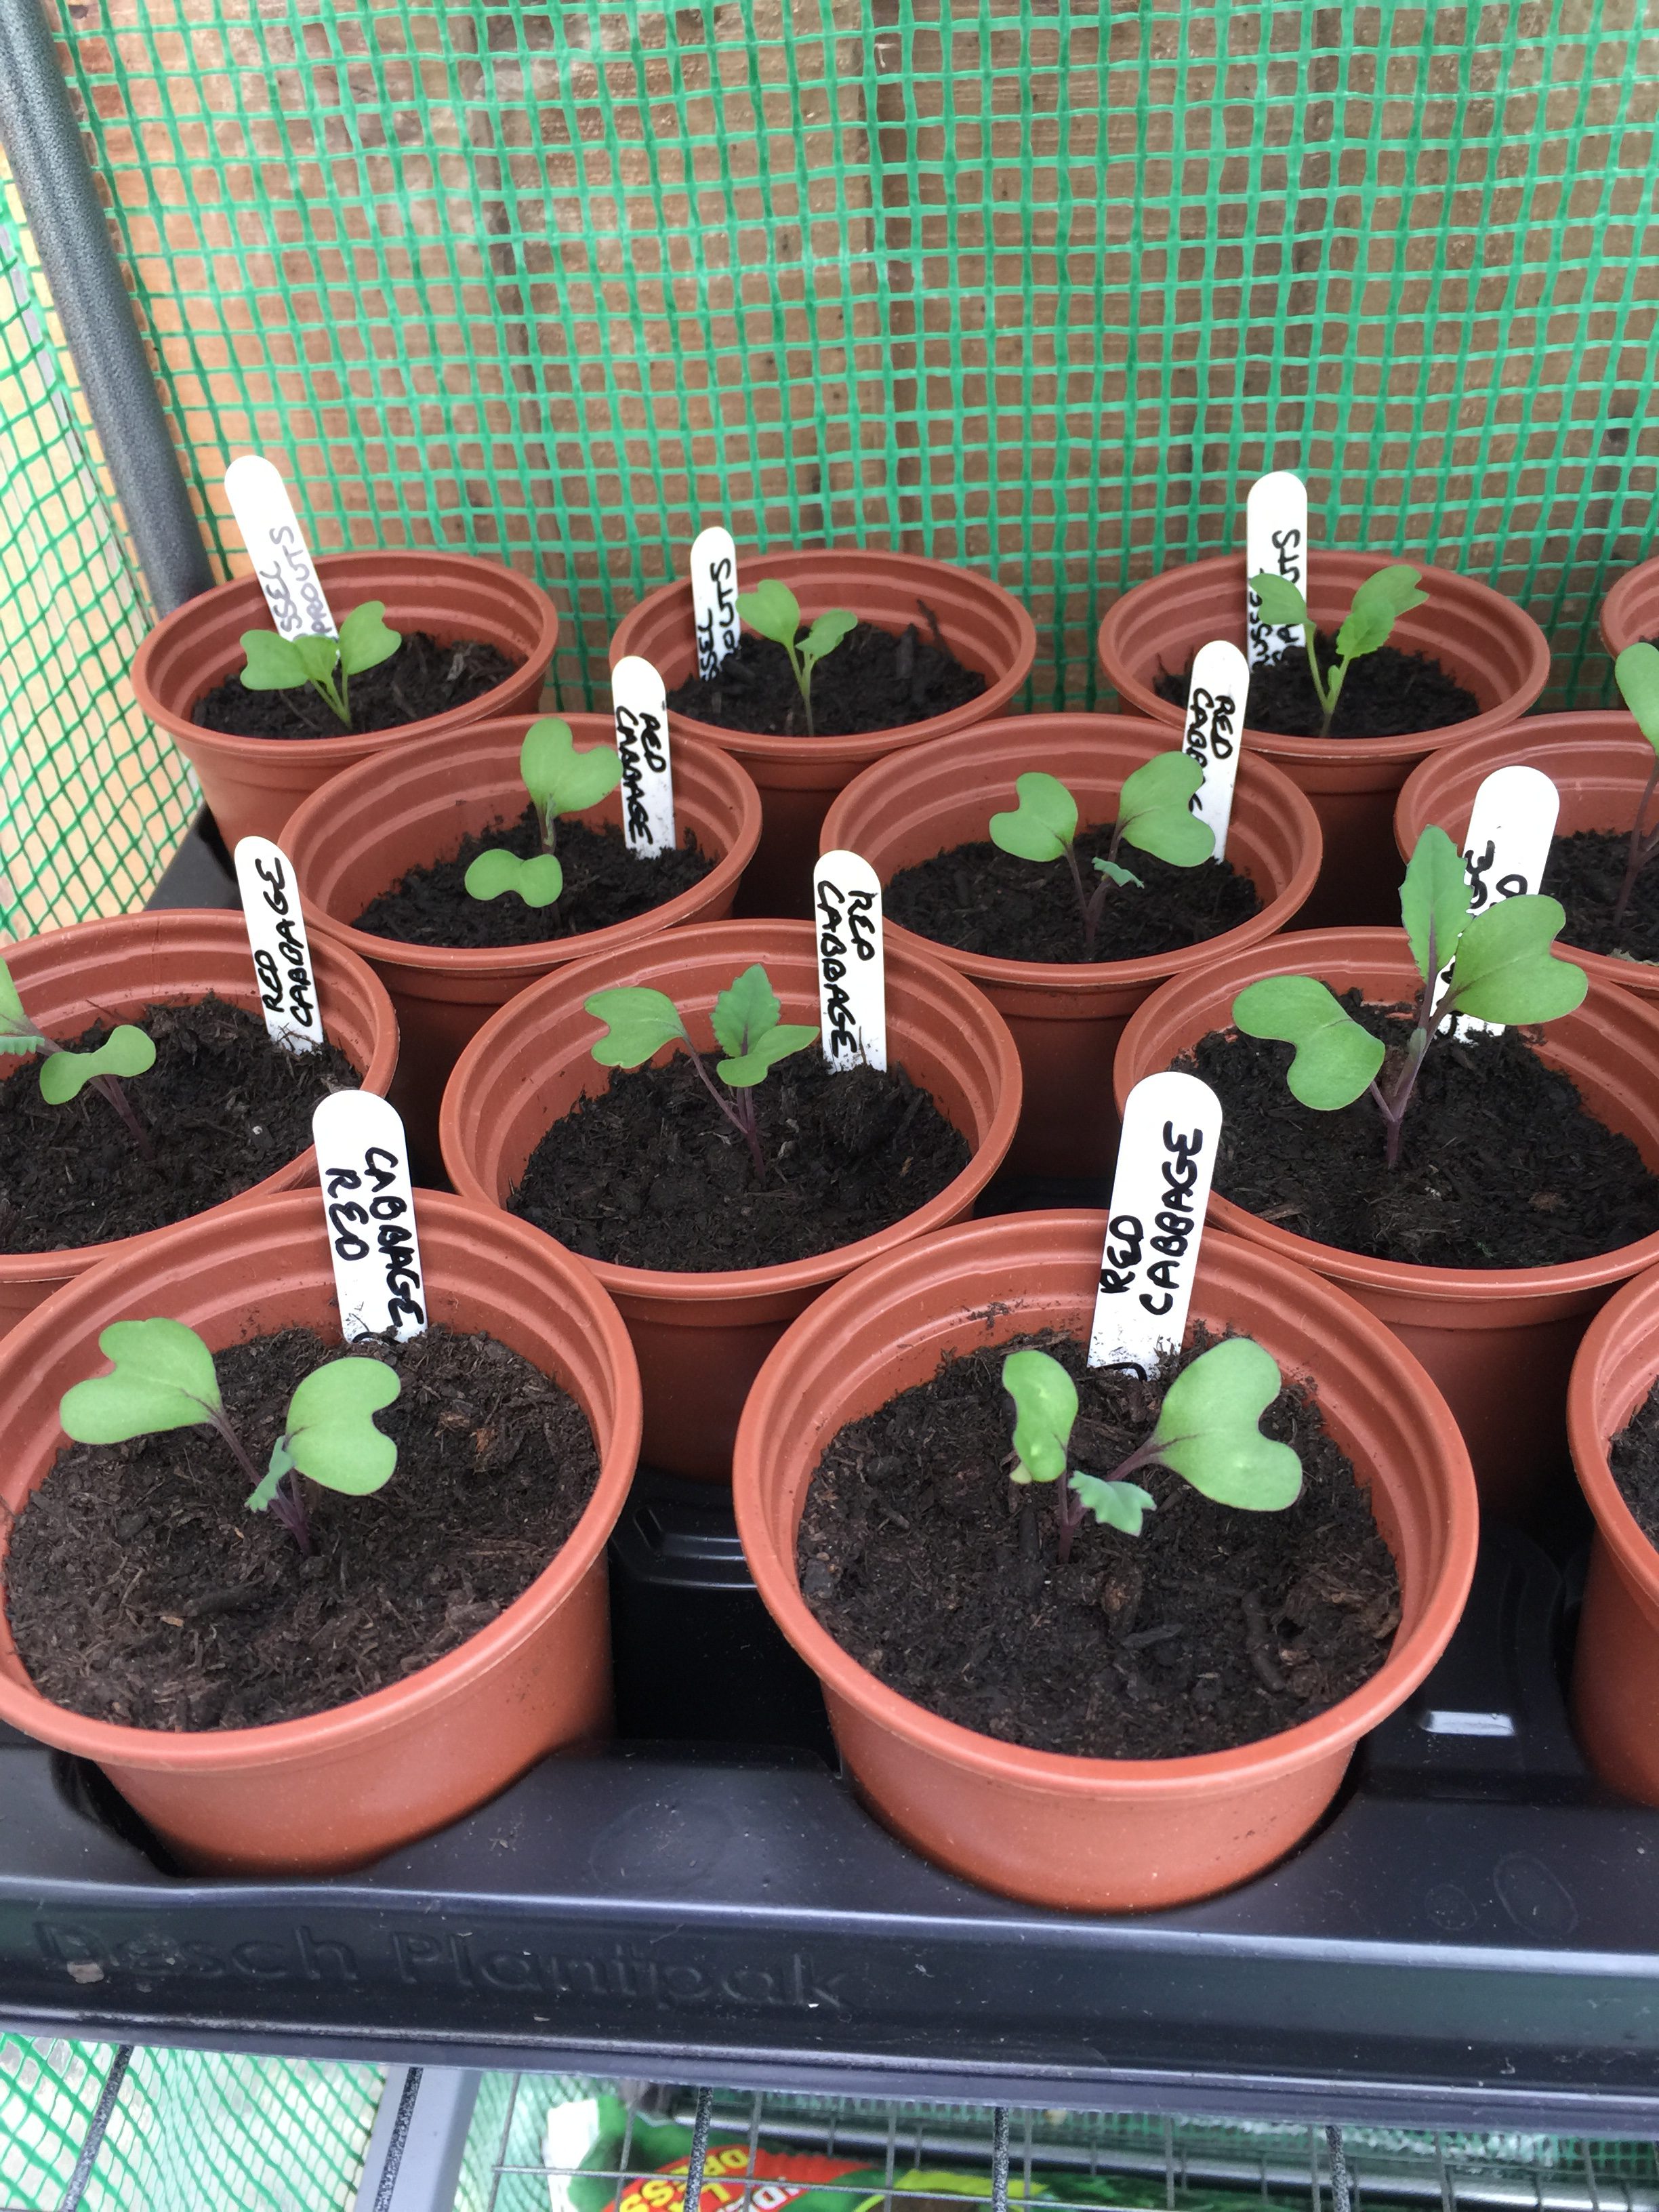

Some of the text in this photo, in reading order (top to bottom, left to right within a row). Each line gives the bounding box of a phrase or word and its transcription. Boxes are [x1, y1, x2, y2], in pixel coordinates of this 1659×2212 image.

[269, 525, 334, 638] PROUTS
[638, 712, 667, 773] RED
[1210, 694, 1236, 760] RED
[615, 705, 653, 844] CABBAGE
[255, 857, 314, 1027] CABBAGE
[817, 880, 857, 1058] CABBAGE
[847, 889, 877, 961] RED
[254, 949, 285, 1012] RED
[325, 1168, 369, 1261] RED
[364, 1147, 425, 1327] CABBAGE
[1100, 1214, 1145, 1294] RED
[1139, 1120, 1203, 1315] CABBAGE
[391, 1929, 852, 2011] Plantpak
